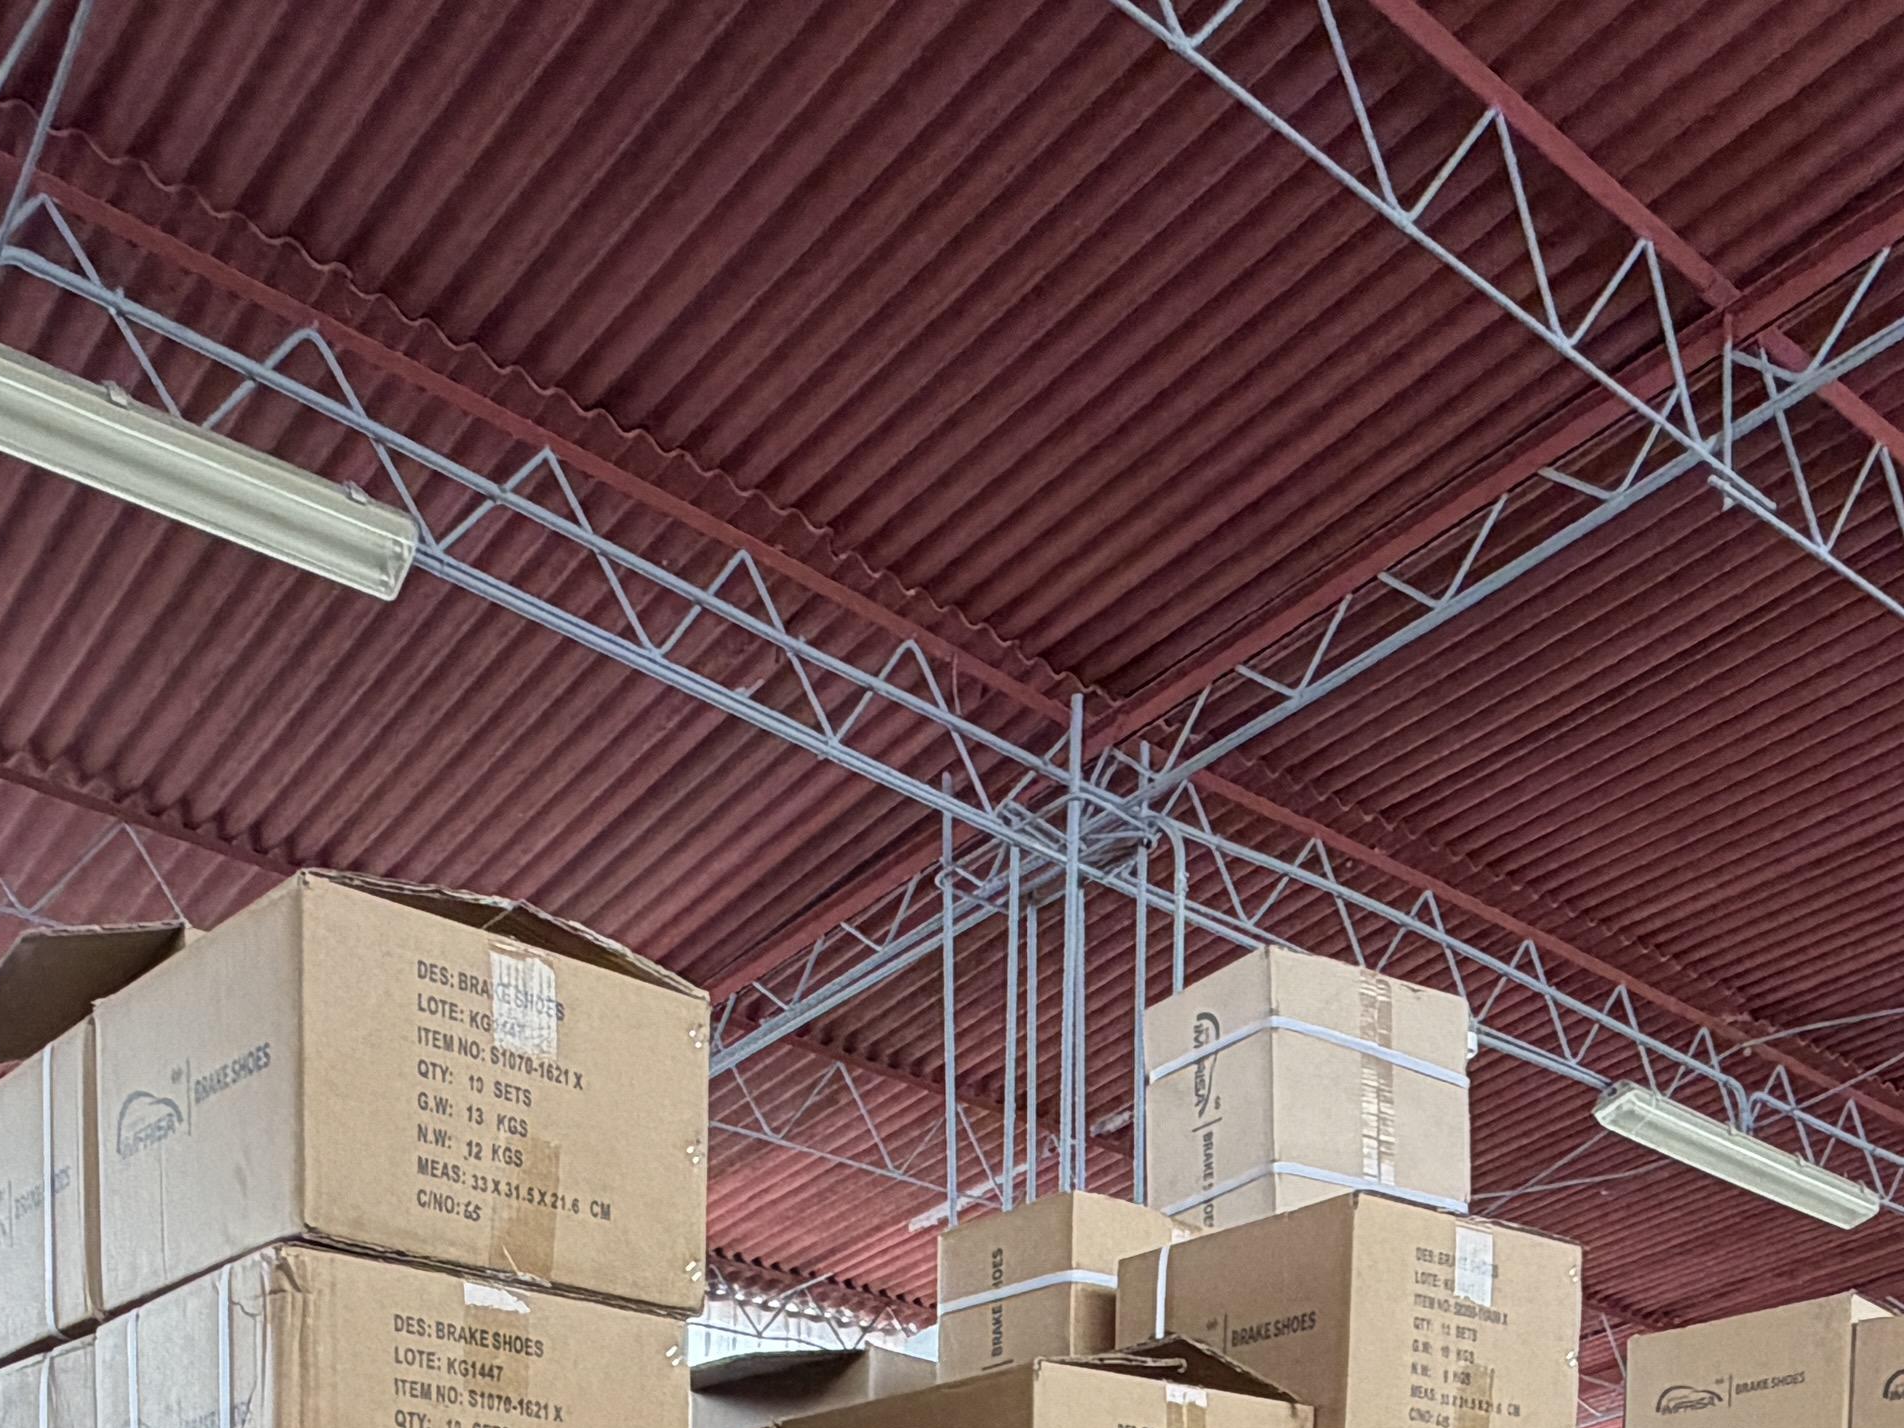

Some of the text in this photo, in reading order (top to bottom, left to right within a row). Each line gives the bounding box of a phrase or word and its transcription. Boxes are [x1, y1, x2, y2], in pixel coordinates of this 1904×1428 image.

[417, 960, 454, 989] DES:
[418, 993, 464, 1023] LOTE:
[417, 1027, 486, 1063] ITEM NO:
[418, 1060, 532, 1108] QTY: SETS
[418, 1092, 528, 1137] G.W: 13 KGS
[418, 1124, 524, 1168] N.W: KGS
[417, 1190, 460, 1215] C/NO:
[418, 1156, 611, 1221] MEAS: CM
[394, 1314, 544, 1357] DES: BRAKE SHOES
[1230, 1311, 1317, 1349] BRAKE SHOES
[395, 1346, 504, 1382] LOTE: KG1447
[395, 1378, 463, 1405] ITEM NO:
[1734, 1377, 1769, 1396] BRAKE
[1770, 1371, 1806, 1390] SHOES
